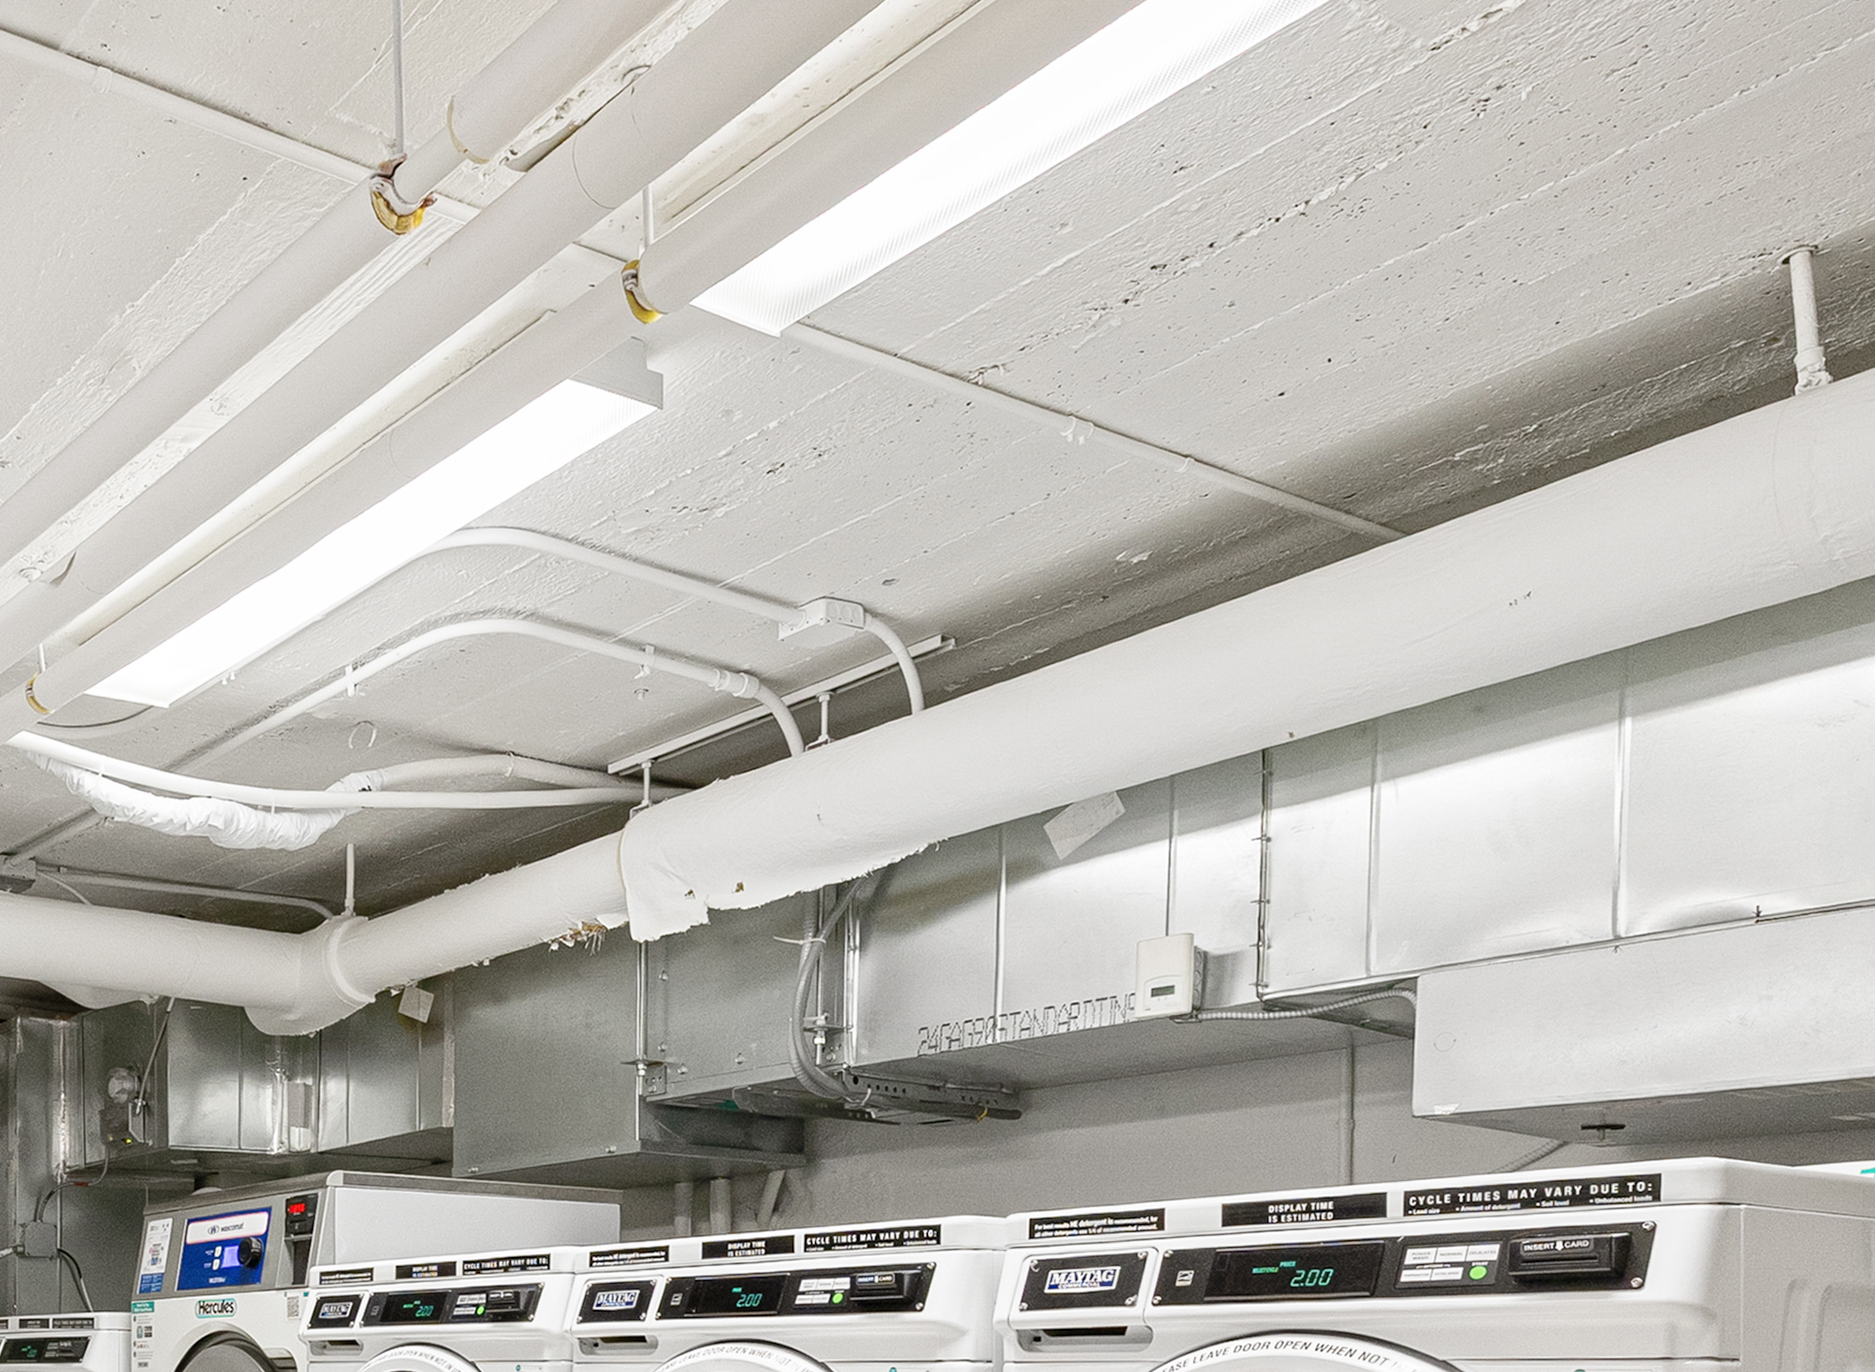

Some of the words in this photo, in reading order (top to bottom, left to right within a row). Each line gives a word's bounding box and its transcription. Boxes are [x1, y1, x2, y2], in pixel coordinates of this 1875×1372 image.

[1409, 1194, 1451, 1206] CYCLE
[1458, 1191, 1500, 1203] TIMES
[1507, 1188, 1537, 1199] MAY
[1544, 1185, 1582, 1197] VARY
[1589, 1183, 1619, 1195] DUE
[1627, 1181, 1653, 1192] TO:
[1268, 1203, 1308, 1213] DISPLAY
[1311, 1201, 1334, 1210] TIME
[1268, 1215, 1278, 1223] IS
[1280, 1212, 1334, 1222] ESTIMATED
[728, 1242, 751, 1250] DISPLAY
[752, 1240, 765, 1248] TIME
[806, 1236, 830, 1245] CYCLE
[833, 1234, 856, 1243] TIMES
[859, 1233, 876, 1242] MAY
[879, 1231, 900, 1240] VARY
[903, 1231, 919, 1239] DUE
[1524, 1242, 1555, 1251] INSERT
[1564, 1240, 1589, 1248] CARD
[1050, 1270, 1114, 1285] MAYTAG
[1290, 1269, 1334, 1287] 2.00
[597, 1292, 636, 1303] MAYTAG
[736, 1293, 762, 1307] 2.00
[198, 1300, 235, 1315] Hercules
[725, 1346, 746, 1354] OPEN
[748, 1347, 772, 1359] WHEN
[1193, 1347, 1229, 1365] LEAVE
[1233, 1341, 1271, 1353] DOOR
[1275, 1340, 1311, 1351] OPEN
[1315, 1343, 1357, 1359] WHEN
[1357, 1350, 1388, 1367] NOT
